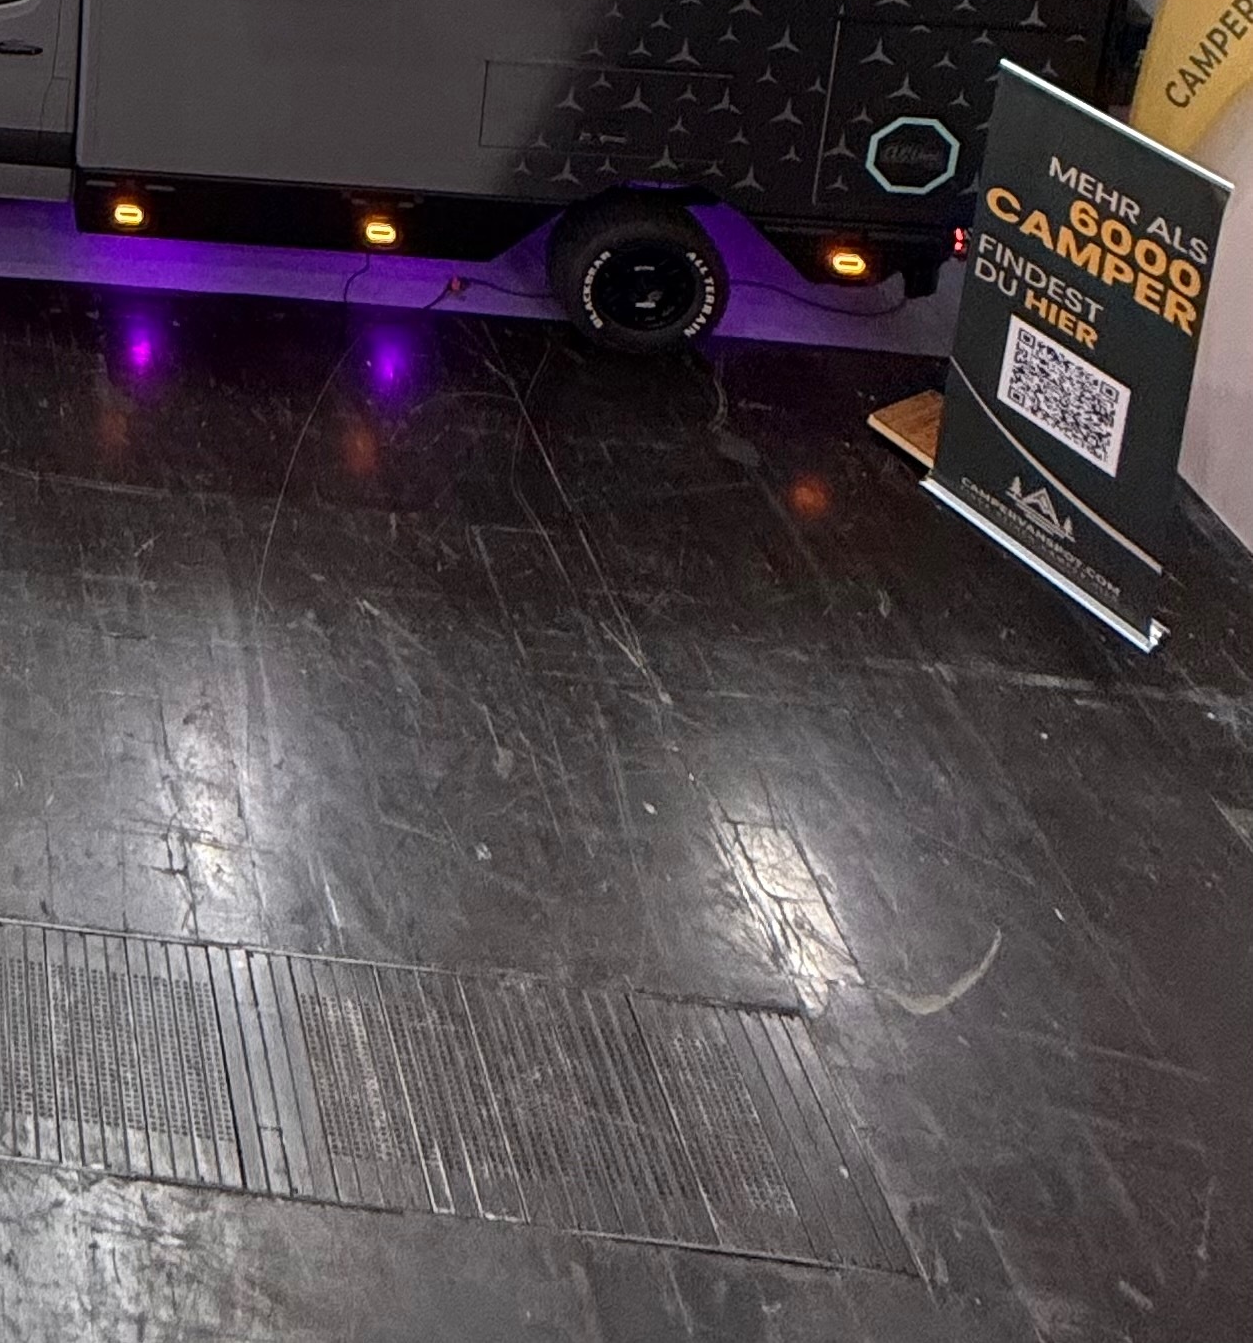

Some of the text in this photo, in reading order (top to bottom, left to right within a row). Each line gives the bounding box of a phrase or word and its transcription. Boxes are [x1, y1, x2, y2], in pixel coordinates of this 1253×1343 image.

[1048, 155, 1210, 265] MEHR ALS
[1069, 199, 1202, 298] 6000
[683, 251, 716, 338] ALL TERRAIN
[974, 256, 1098, 351] DU HIER
[978, 233, 1105, 323] FINDEST
[985, 186, 1197, 338] CAMPER
